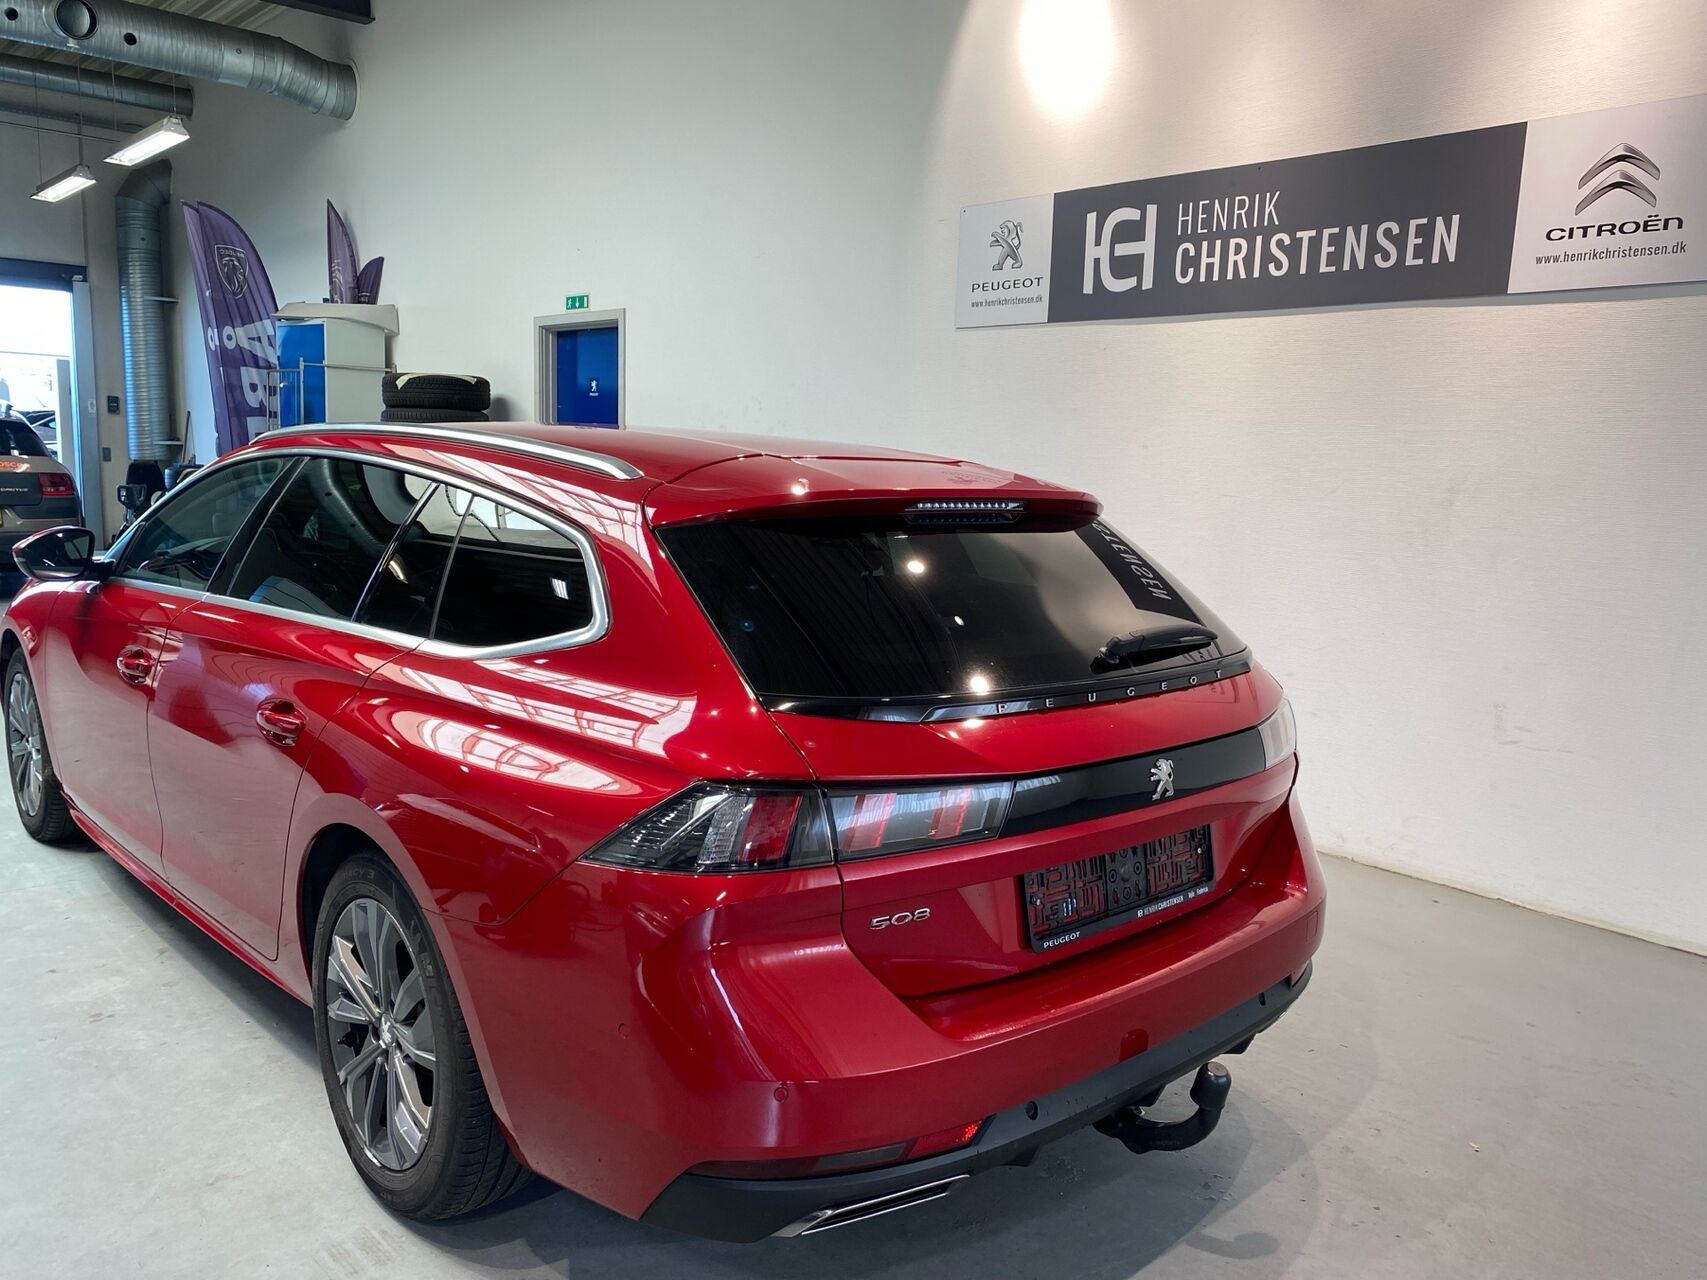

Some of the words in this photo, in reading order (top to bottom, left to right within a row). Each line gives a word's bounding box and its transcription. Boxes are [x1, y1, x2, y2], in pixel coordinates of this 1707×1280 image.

[1177, 191, 1280, 236] HENRIK
[1545, 214, 1683, 241] CITROËN
[1175, 214, 1460, 284] CHRISTENSEN
[1535, 241, 1687, 265] www.henrikchristensen.dk
[971, 277, 1043, 293] PEUGEOT
[971, 294, 1042, 308] www.henrikchristensen.dk
[996, 669, 1222, 714] PEUGEOT
[870, 907, 930, 929] 508
[1043, 931, 1081, 949] PEUGEOT
